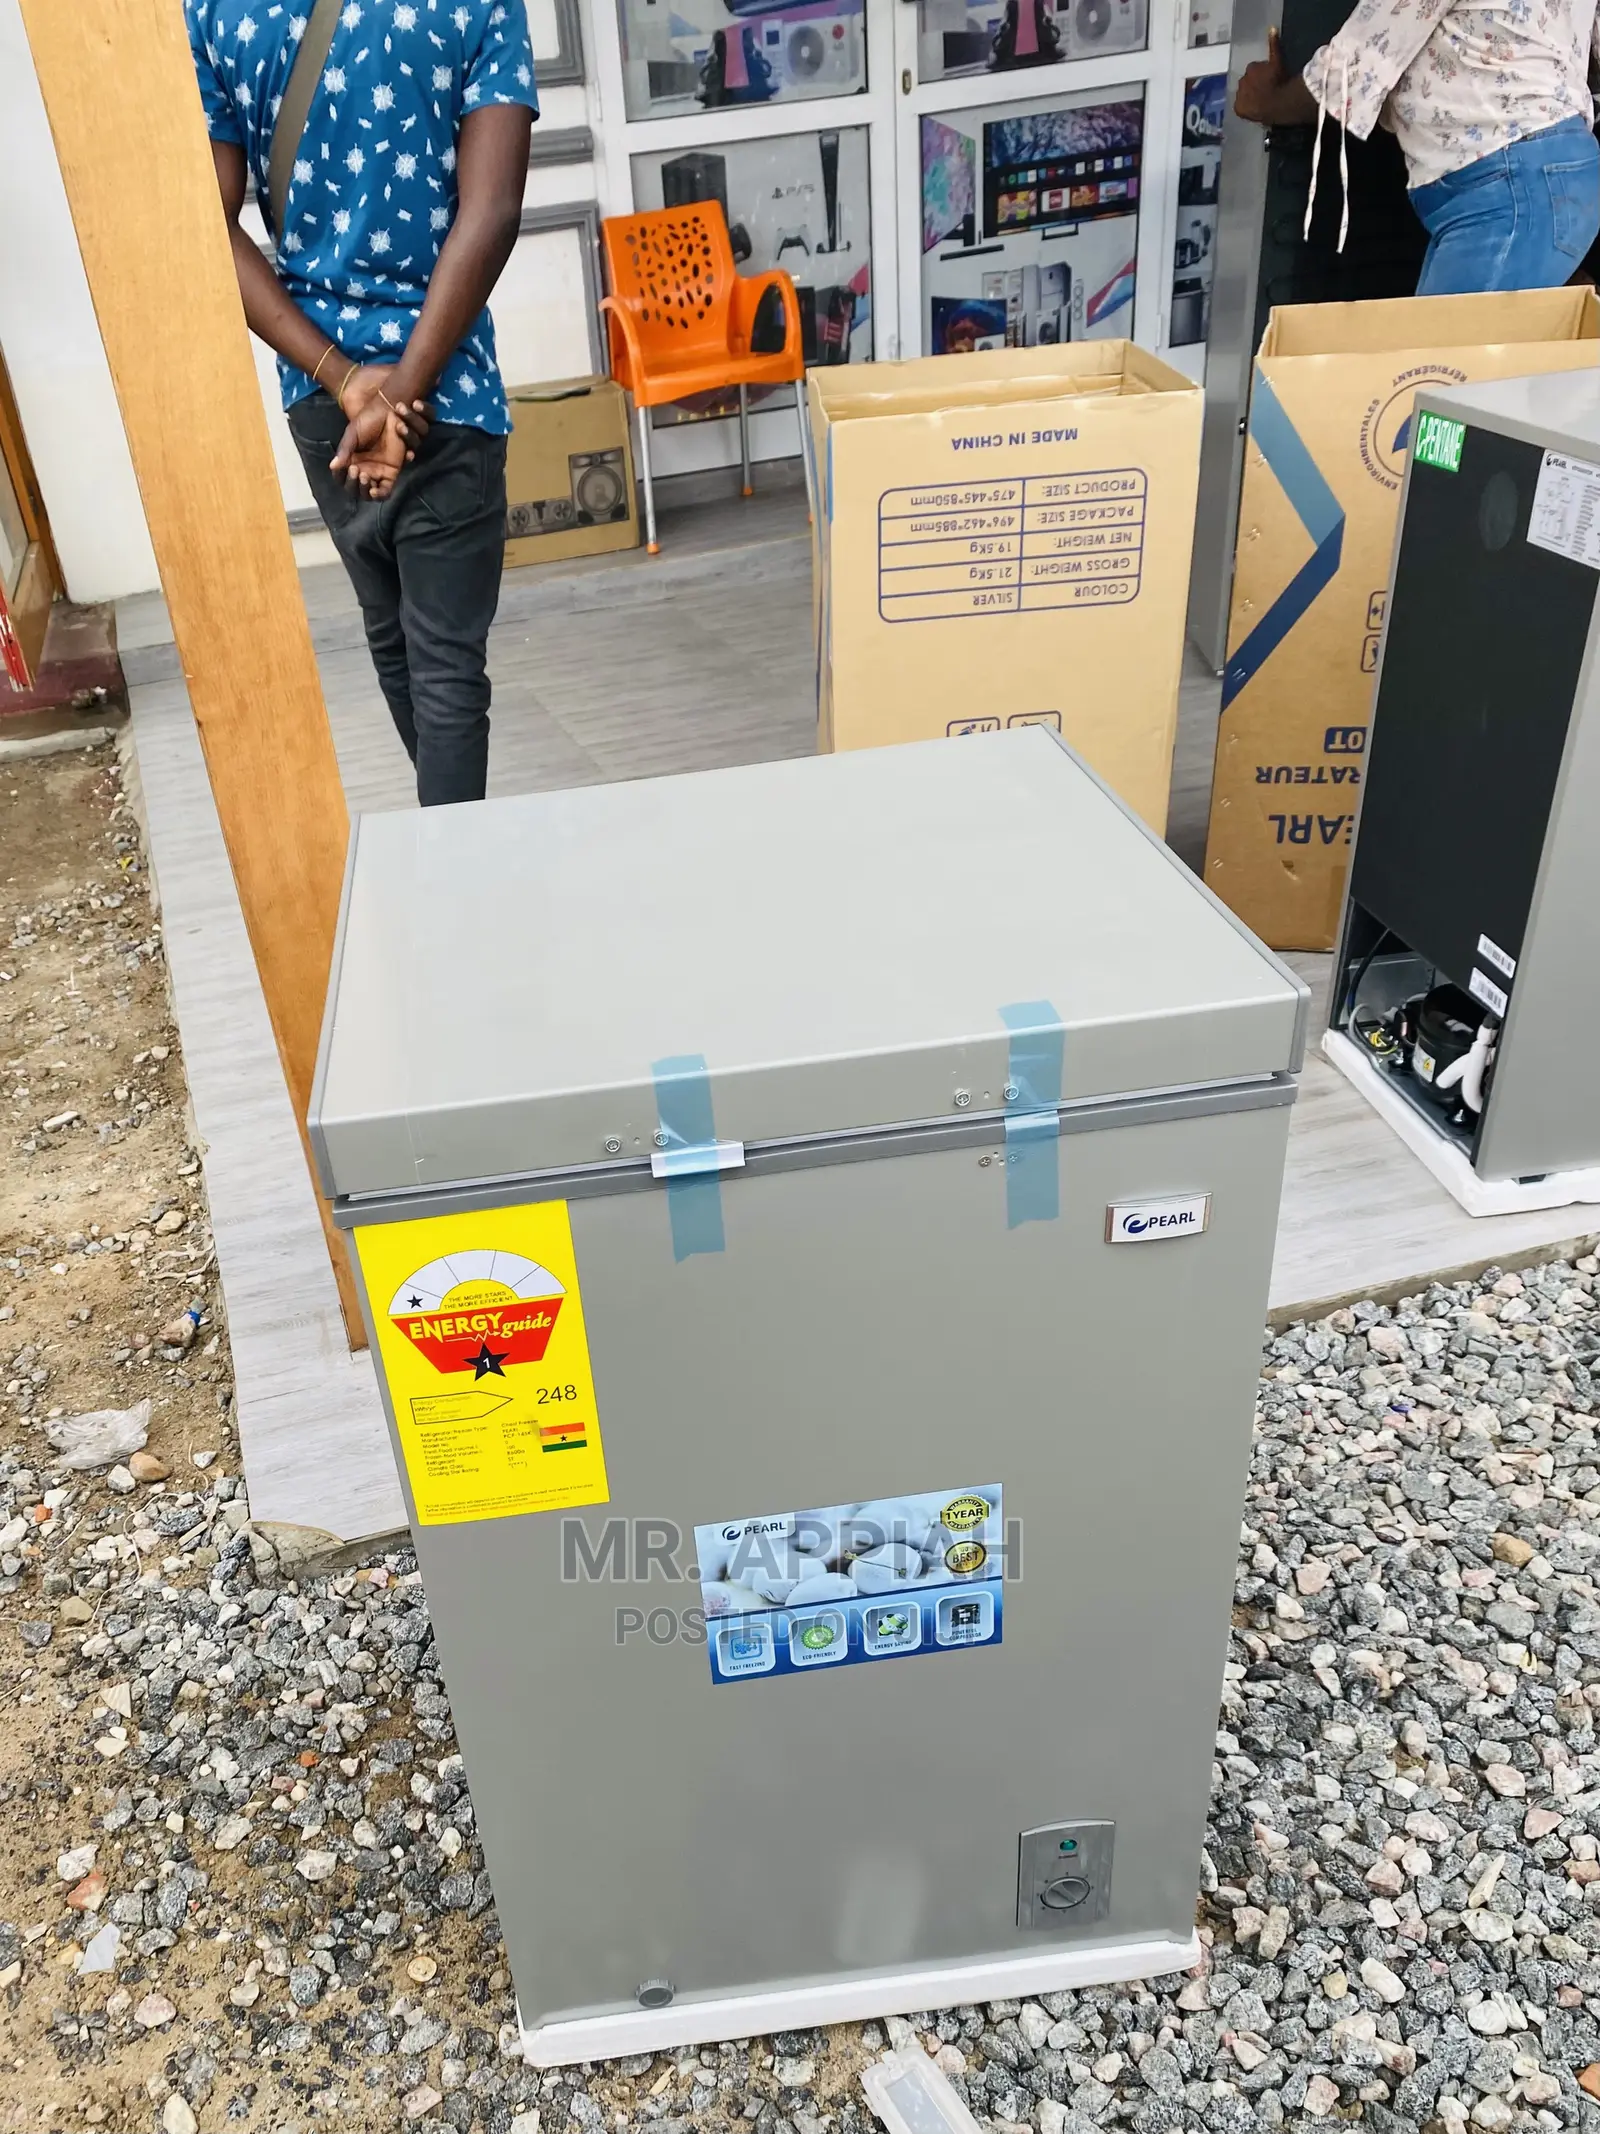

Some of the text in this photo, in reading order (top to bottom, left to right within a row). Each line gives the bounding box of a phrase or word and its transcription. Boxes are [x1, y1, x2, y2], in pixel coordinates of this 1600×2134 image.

[951, 428, 1078, 450] MADE IN CHINA
[1042, 479, 1136, 497] PRODUCT SIZE:
[1037, 506, 1134, 524] PACKAGE SIZE:
[1054, 532, 1133, 548] NET WEIGHT:
[970, 542, 1012, 555] 19.5Kg
[969, 567, 1012, 580] 21.5Kg
[1031, 557, 1131, 575] GROSS WEIGHT:
[1074, 583, 1129, 597] COLOUR
[972, 593, 1013, 606] SILVER
[1148, 1211, 1196, 1228] PEARL
[409, 1311, 552, 1343] ENERGY guide
[482, 1358, 491, 1369] 1
[536, 1384, 577, 1405] 248
[953, 1508, 984, 1519] YEAR
[744, 1521, 787, 1536] PEARL
[952, 1550, 979, 1564] BEST
[802, 1651, 837, 1660] ECO-FRIENDLY
